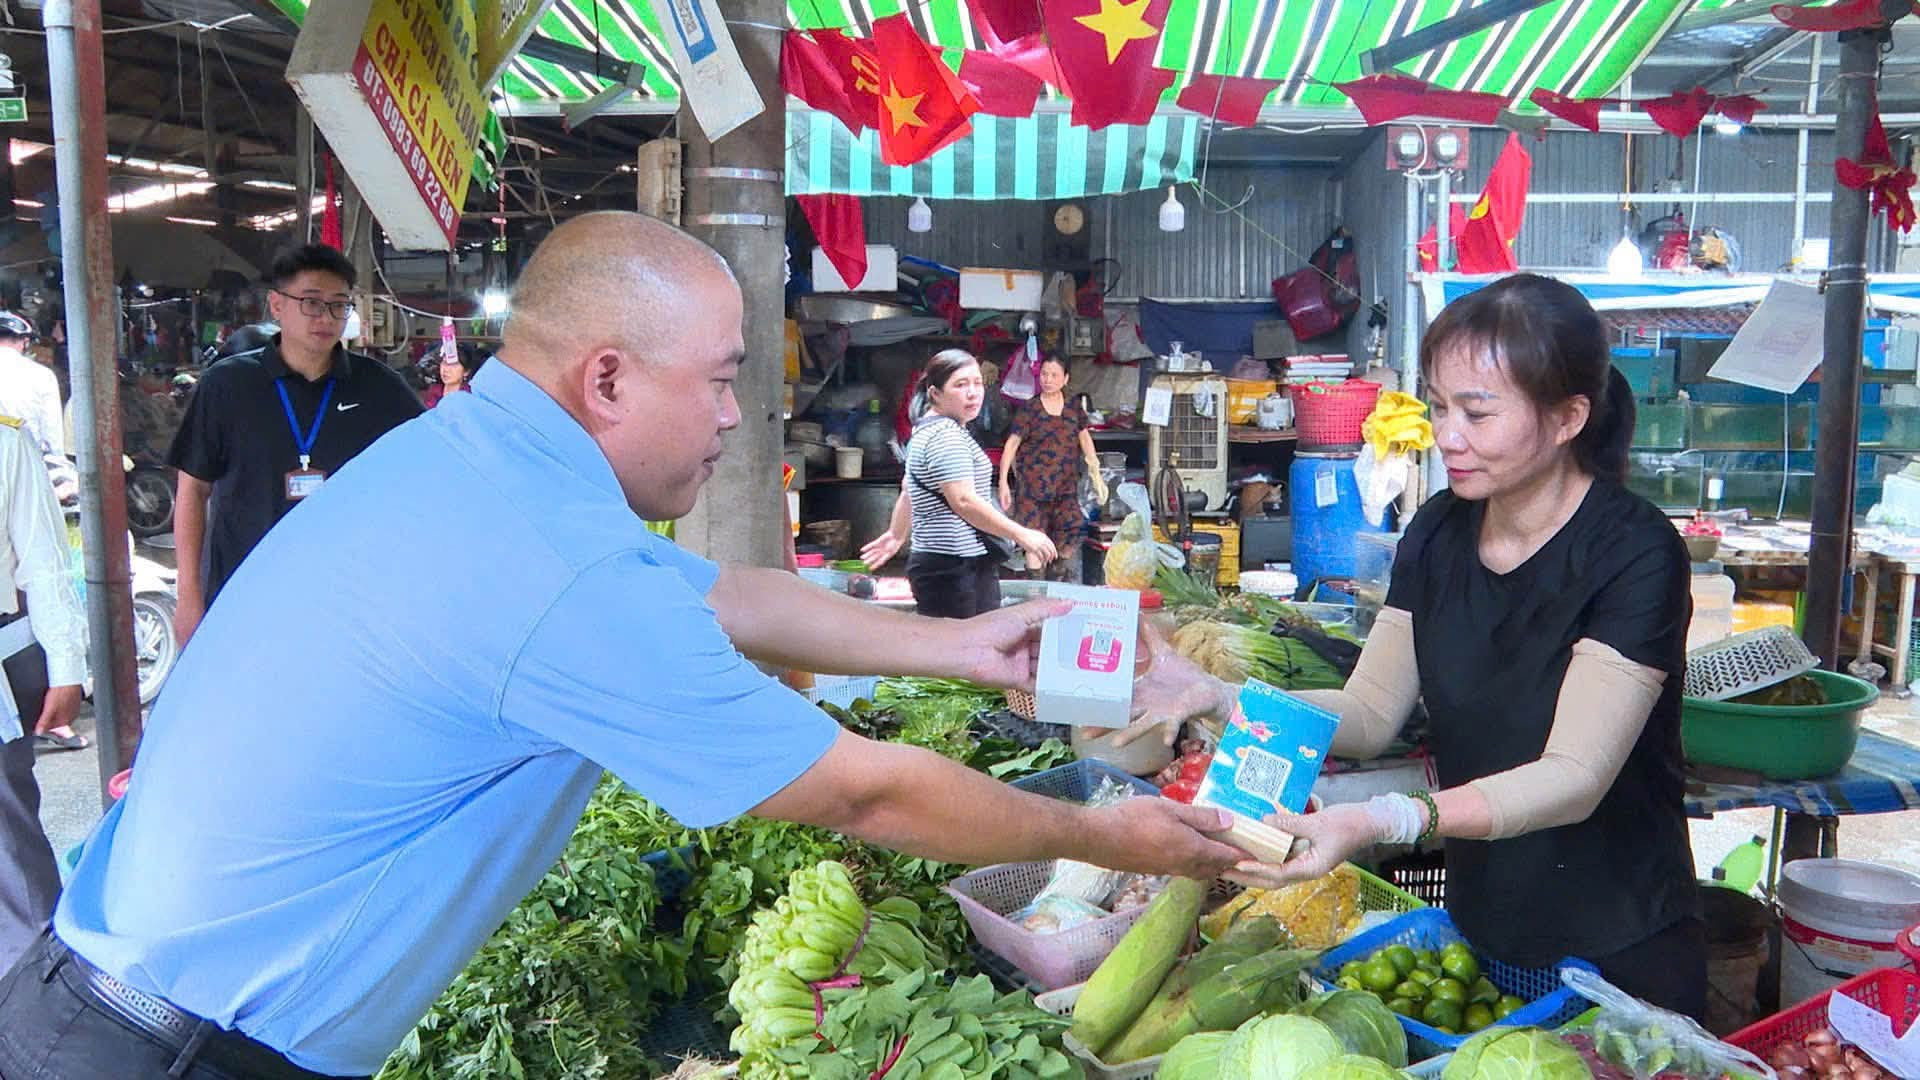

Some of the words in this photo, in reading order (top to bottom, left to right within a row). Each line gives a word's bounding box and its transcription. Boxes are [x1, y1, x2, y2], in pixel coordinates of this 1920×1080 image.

[375, 22, 411, 98] CHẢ
[408, 83, 432, 136] CÁ
[382, 95, 413, 155] 0983
[410, 145, 428, 181] 69
[425, 171, 441, 207] 22
[439, 196, 454, 230] 68
